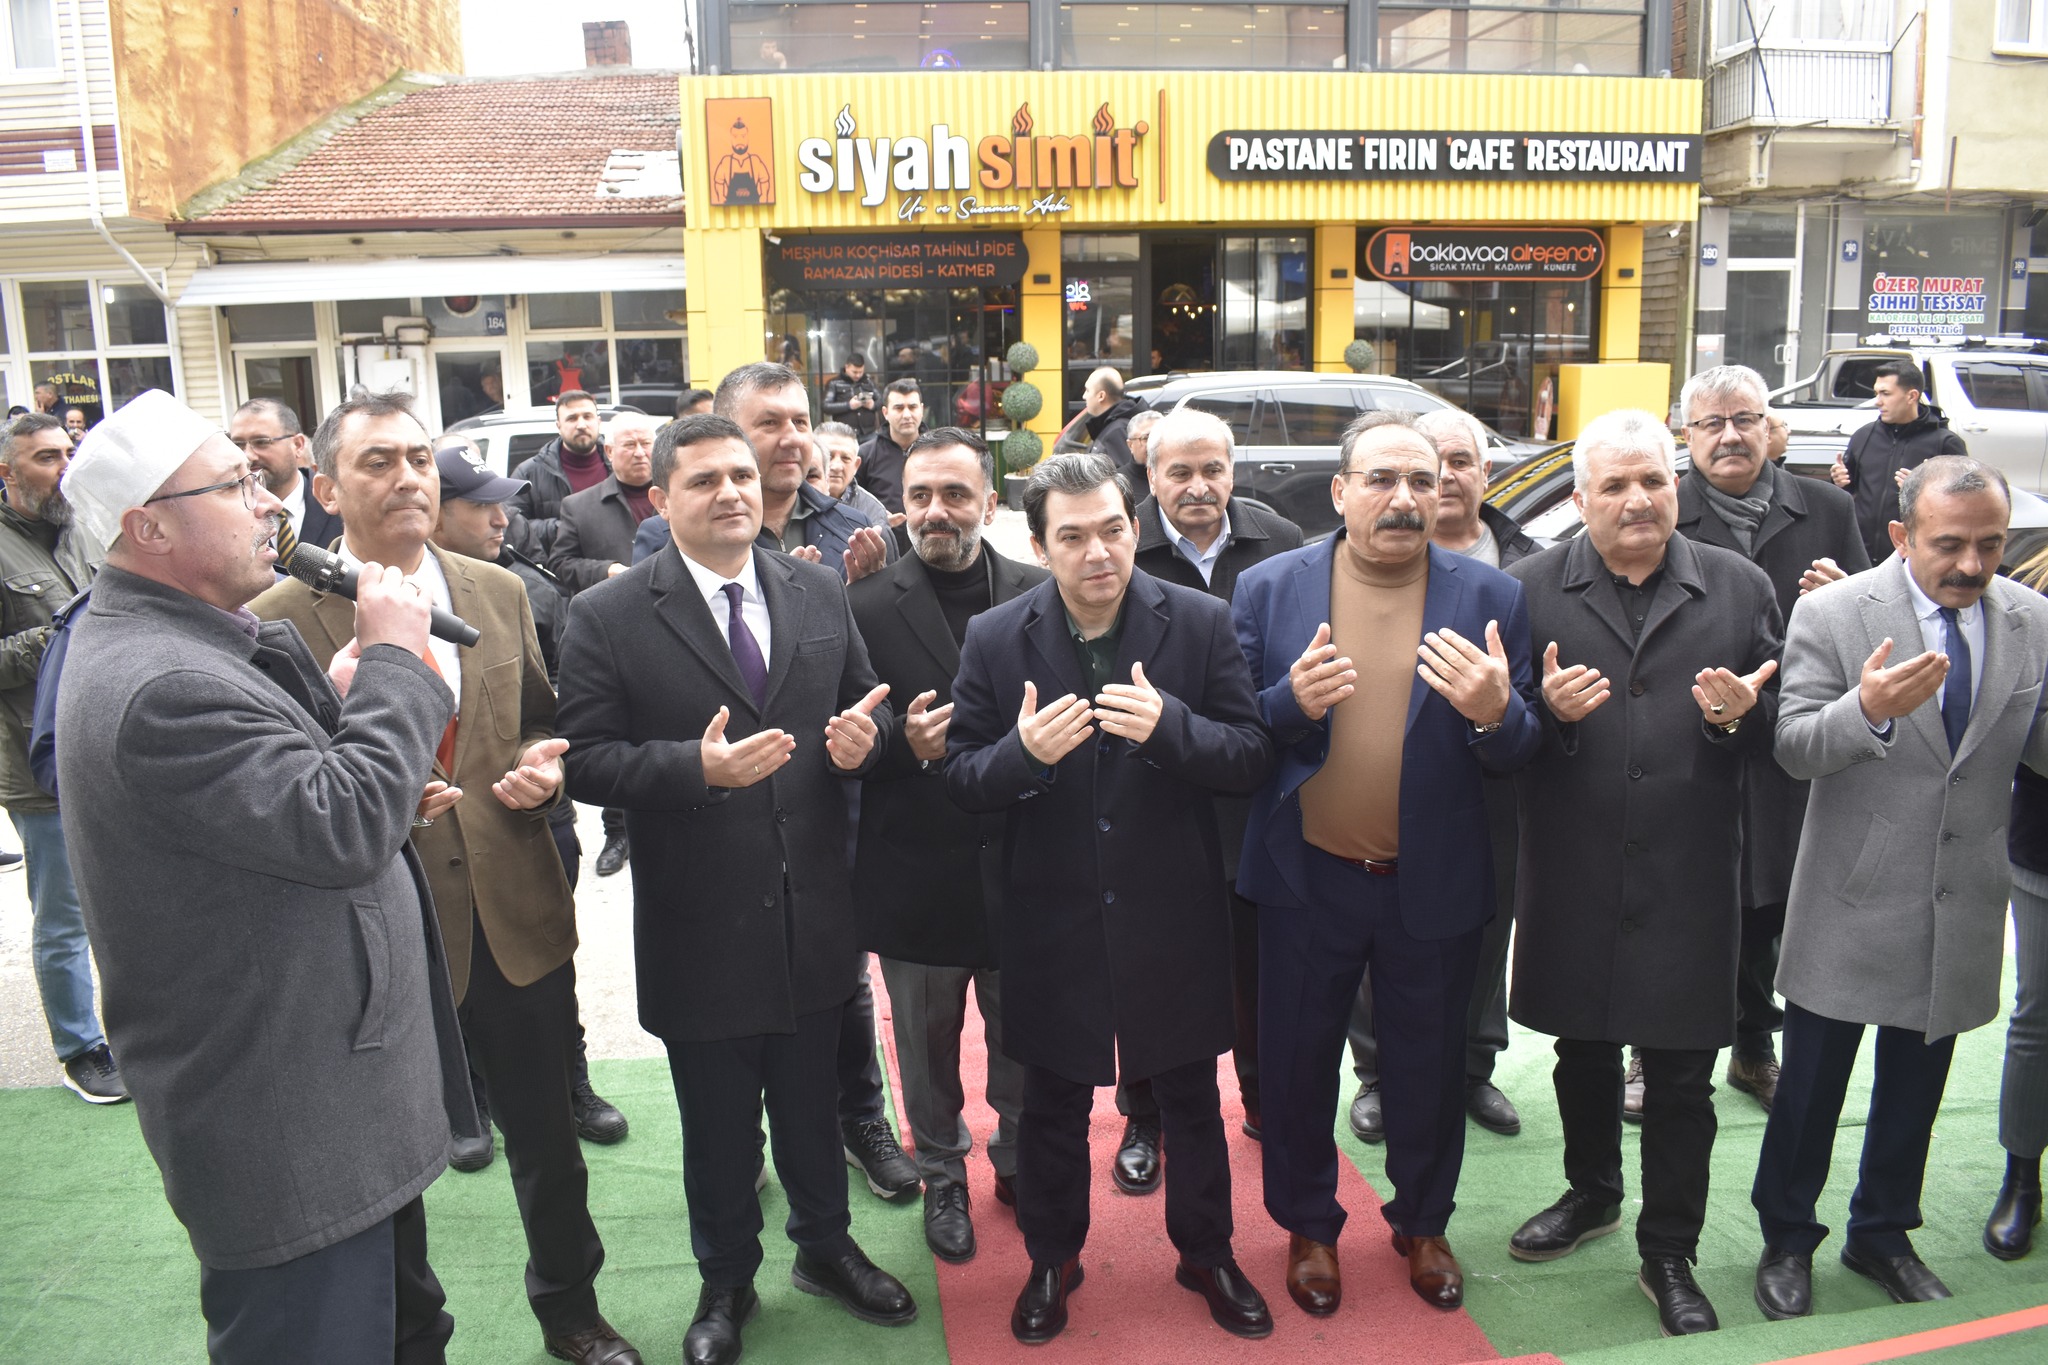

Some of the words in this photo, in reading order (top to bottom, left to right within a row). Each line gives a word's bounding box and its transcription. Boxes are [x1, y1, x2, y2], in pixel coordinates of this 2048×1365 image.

[798, 104, 971, 206] siyah
[978, 101, 1149, 189] simit
[1229, 137, 1353, 171] PASTANE
[1364, 138, 1438, 171] FIRIN
[1449, 138, 1515, 171] CAFE
[1526, 139, 1690, 172] RESTAURANT
[898, 195, 927, 222] Un
[935, 205, 951, 214] ve
[781, 246, 843, 263] MEŞHUR
[924, 240, 980, 257] TAHİNLİ
[983, 241, 1016, 257] PİDE
[803, 264, 876, 280] RAMAZAN
[878, 262, 924, 278] PİDESİ
[937, 263, 996, 277] KATMER
[1429, 263, 1457, 272] SICAK
[1460, 263, 1486, 272] TATLI
[1494, 263, 1533, 272] KADAYIF
[1874, 273, 1918, 292] ÖZER
[1922, 278, 1984, 293] MURAT
[1069, 302, 1087, 310] WC
[487, 316, 505, 329] 164
[1920, 314, 1931, 323] VE
[1933, 314, 1945, 323] SU
[1889, 325, 1917, 334] PETEK
[47, 373, 96, 390] OSTLAR
